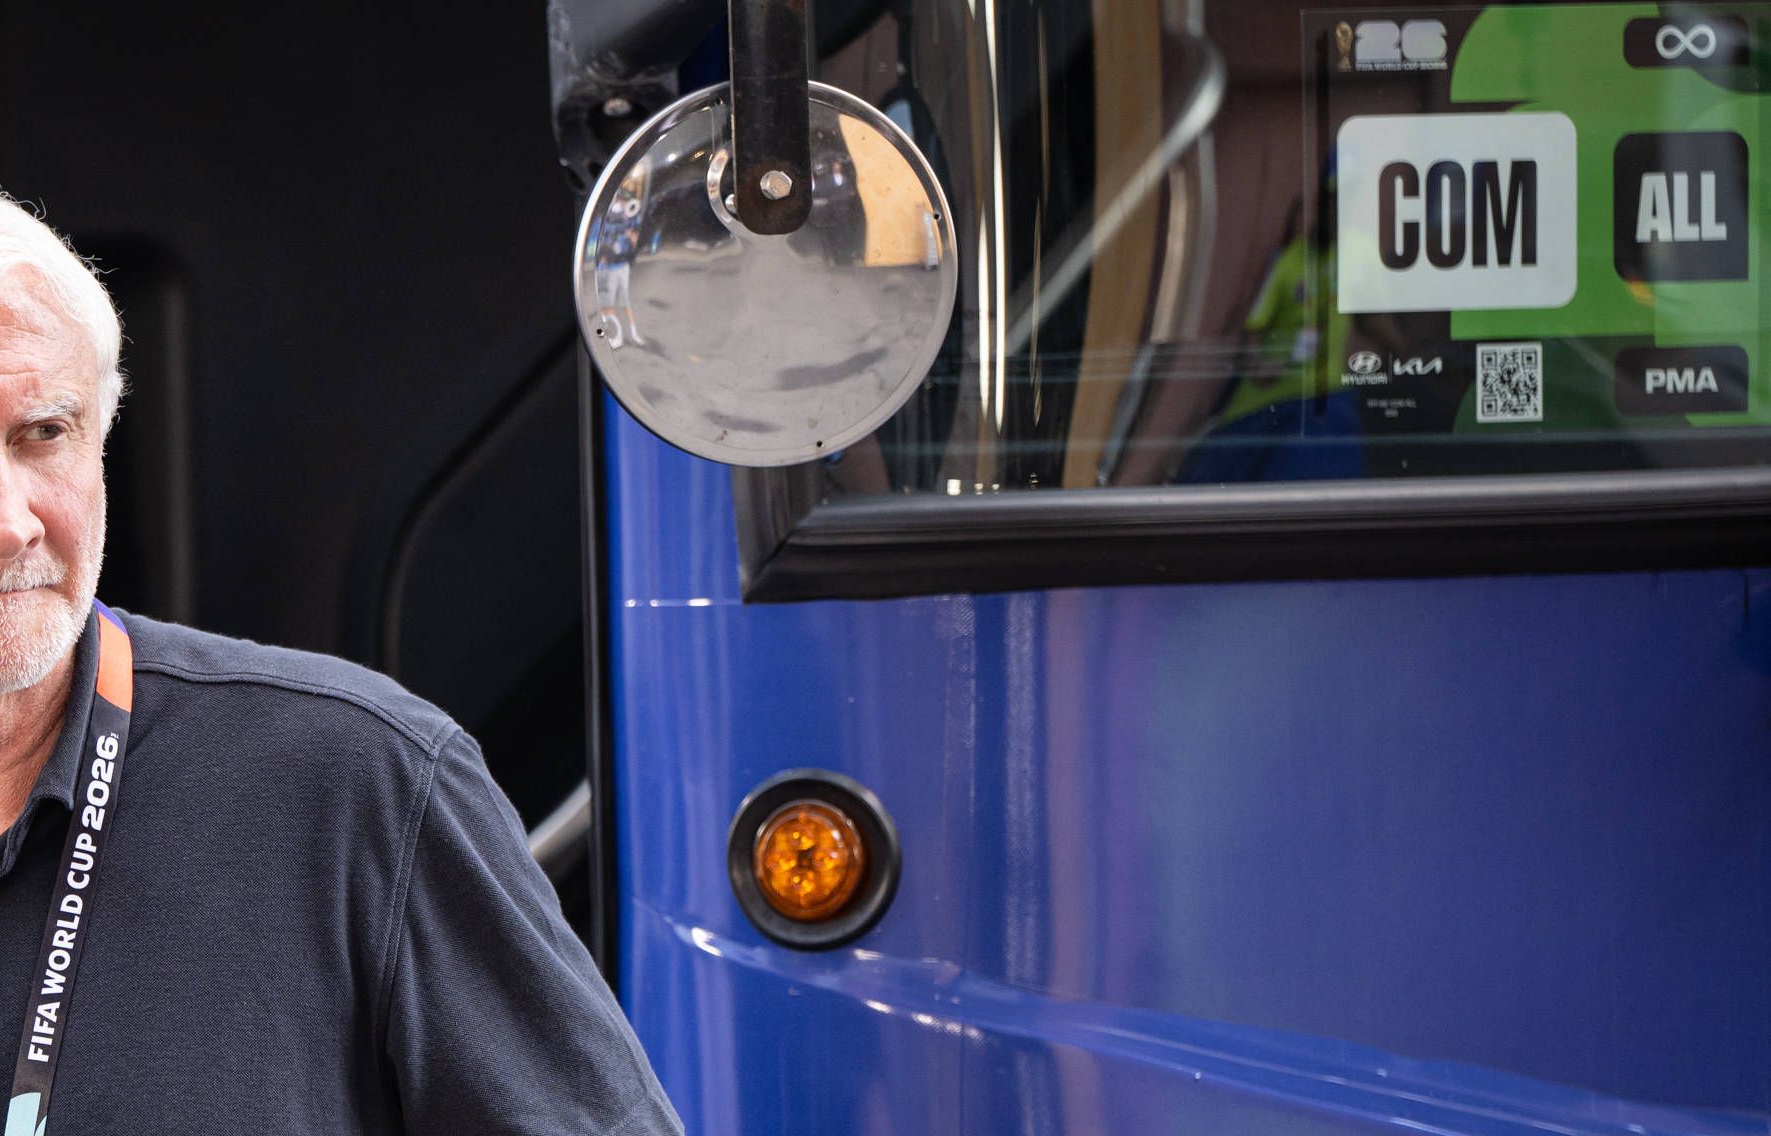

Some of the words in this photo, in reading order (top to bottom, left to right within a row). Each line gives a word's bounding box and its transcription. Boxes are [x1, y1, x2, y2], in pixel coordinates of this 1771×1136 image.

[1378, 159, 1538, 271] COM
[1636, 170, 1727, 243] ALL
[1645, 367, 1719, 395] PMA
[81, 734, 119, 831] 2026
[67, 832, 98, 890] CUP
[41, 894, 84, 995] WORLD
[28, 1001, 61, 1063] FIFA
